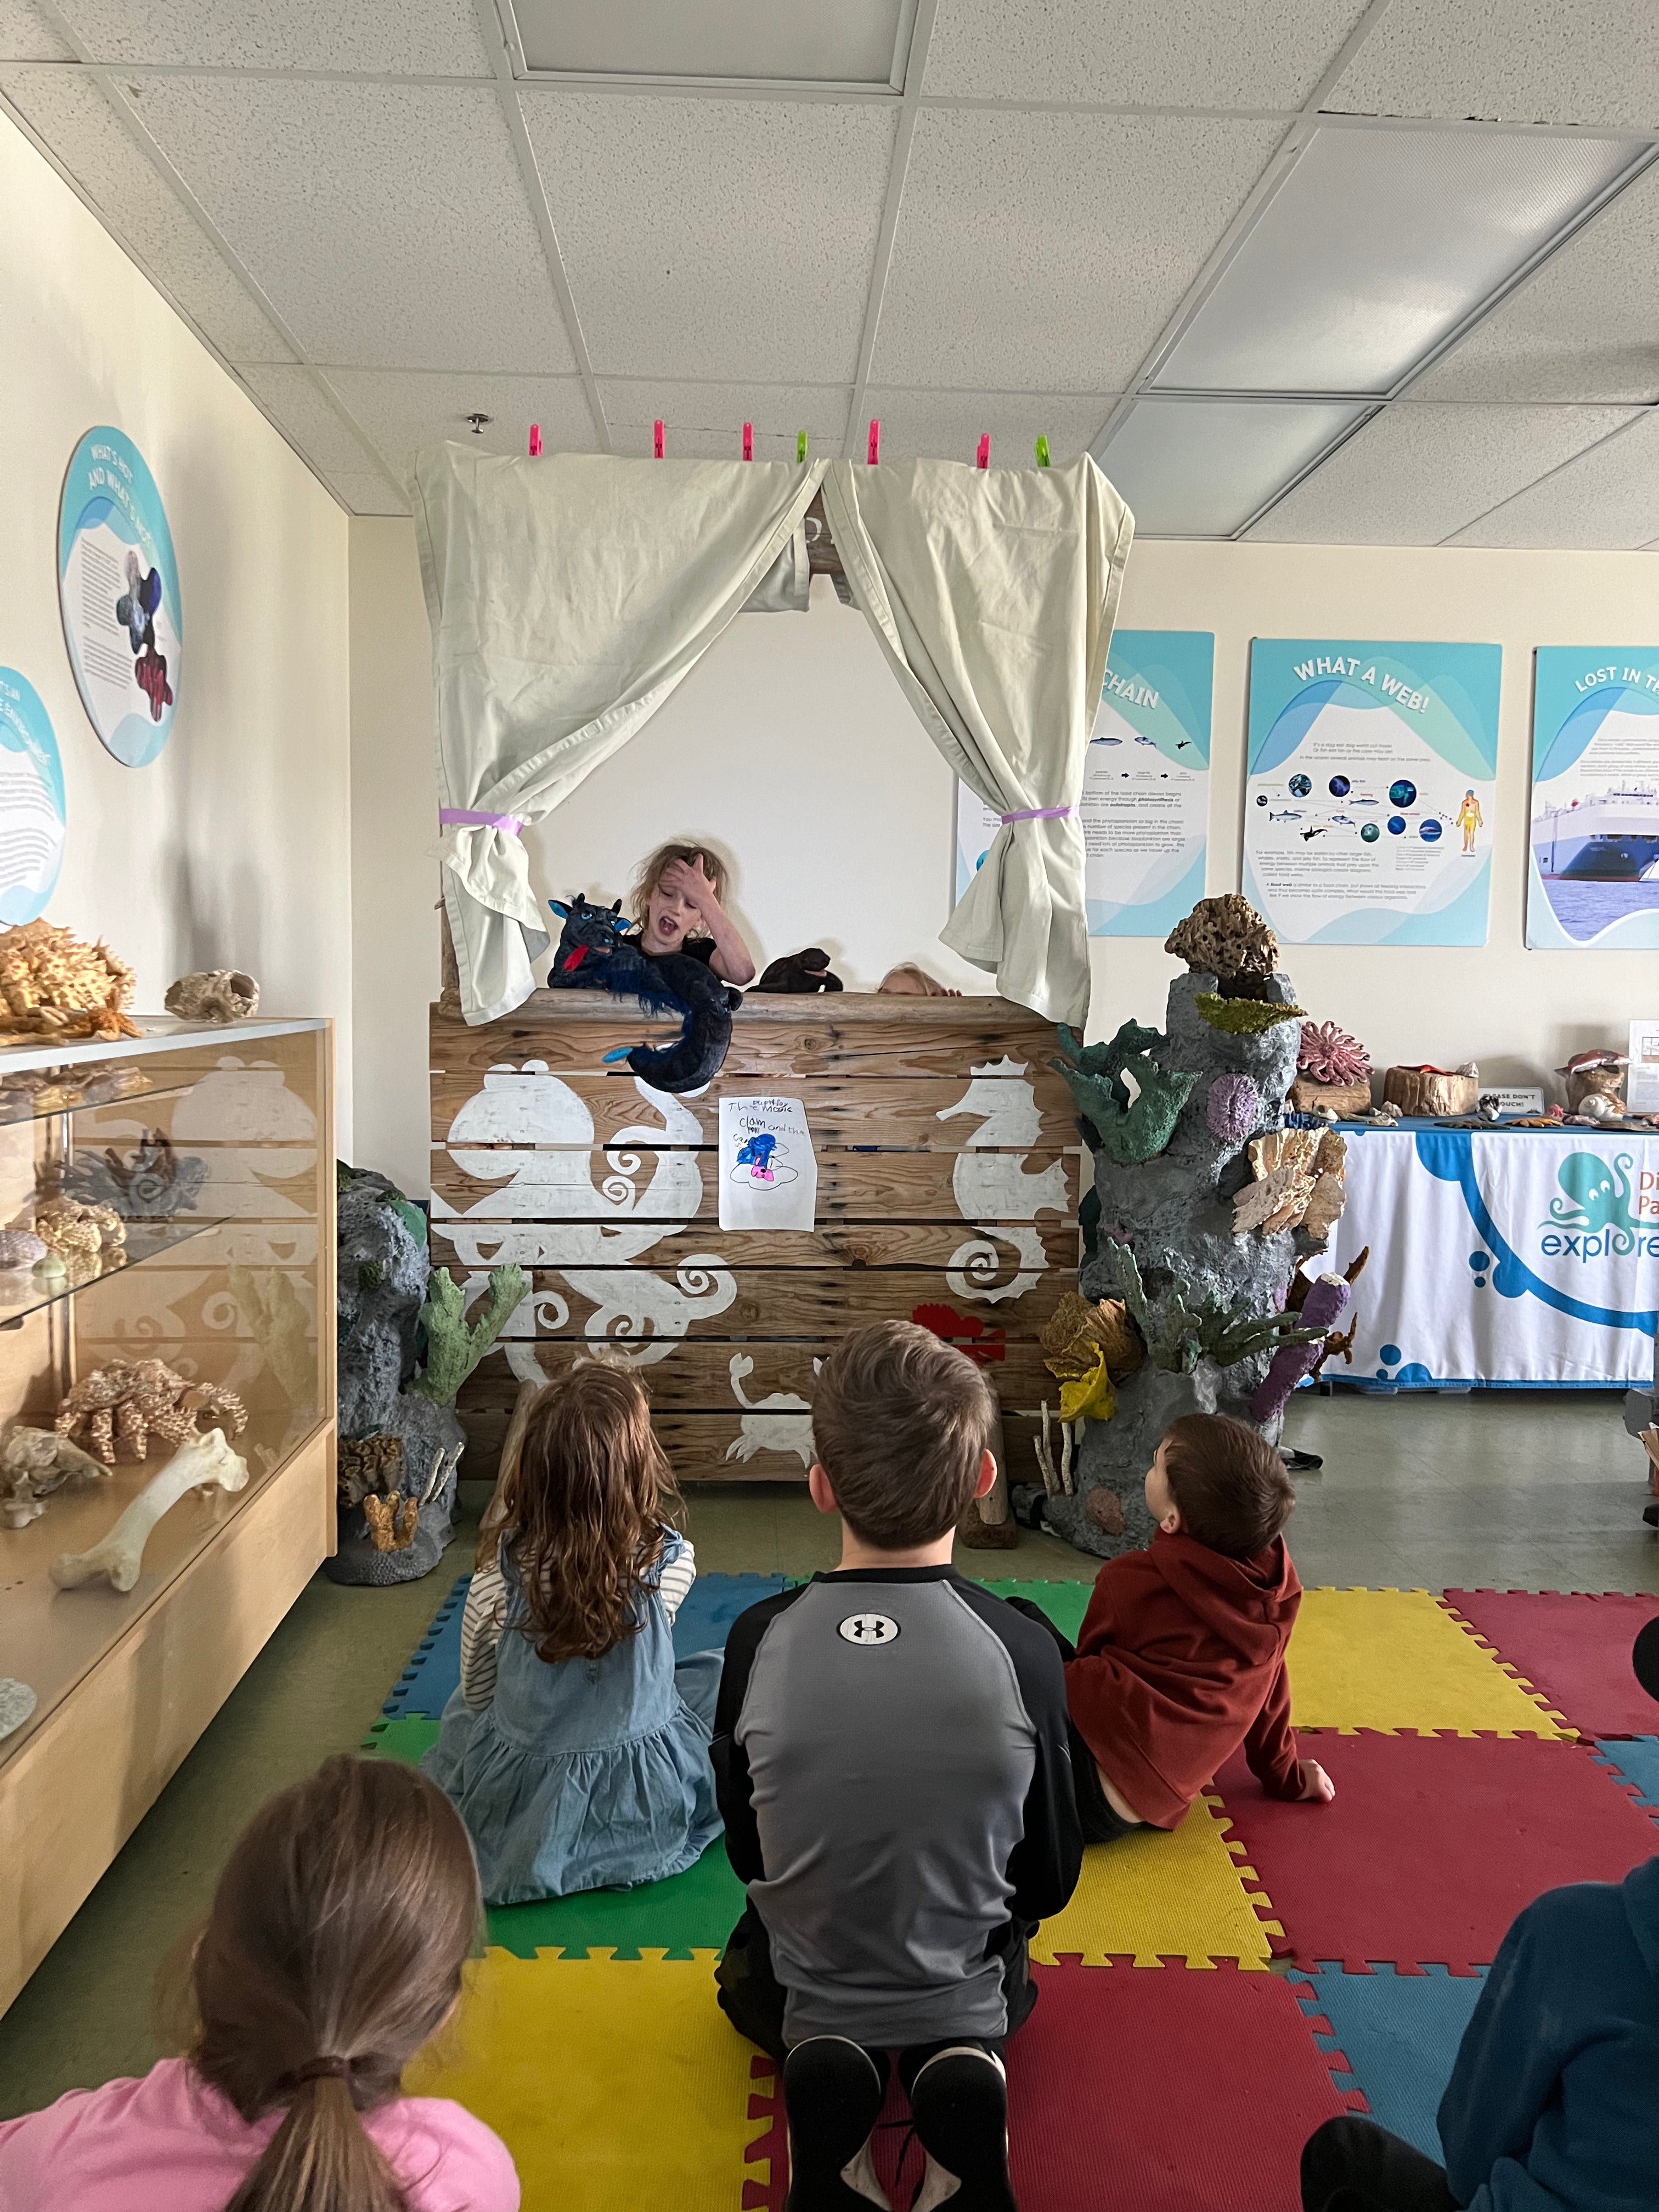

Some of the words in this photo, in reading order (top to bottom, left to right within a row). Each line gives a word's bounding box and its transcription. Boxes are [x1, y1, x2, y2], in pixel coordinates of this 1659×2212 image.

[88, 467, 105, 490] AND
[1294, 656, 1361, 681] WHAT
[1361, 667, 1376, 685] A
[1381, 674, 1429, 714] WEB!
[1575, 667, 1617, 692] LOST
[1622, 667, 1641, 684] IN
